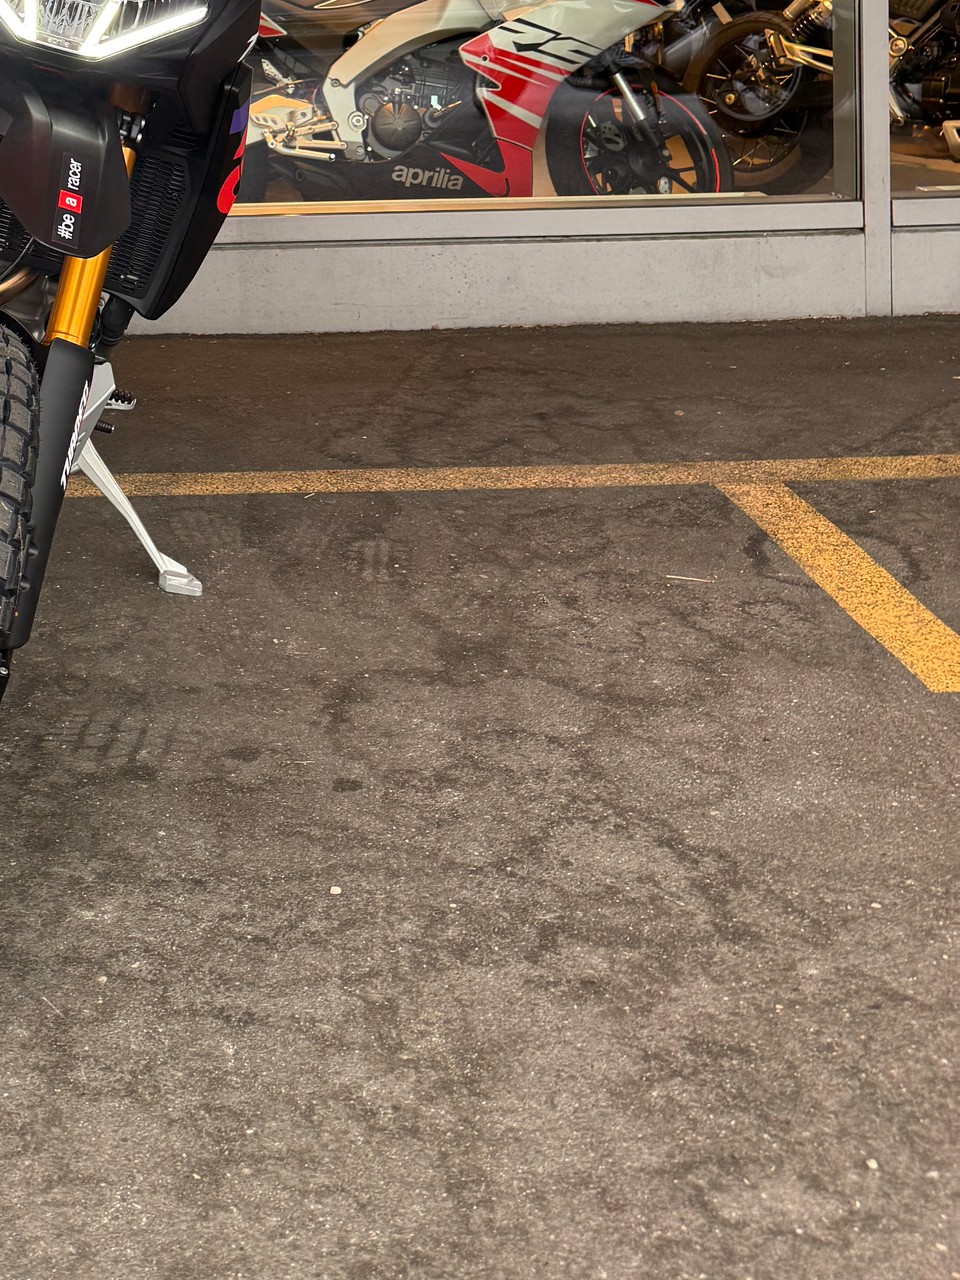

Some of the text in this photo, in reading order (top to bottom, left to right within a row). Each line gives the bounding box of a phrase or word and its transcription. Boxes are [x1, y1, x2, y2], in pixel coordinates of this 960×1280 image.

[57, 157, 82, 240] #be a racer
[391, 165, 464, 191] aprilia
